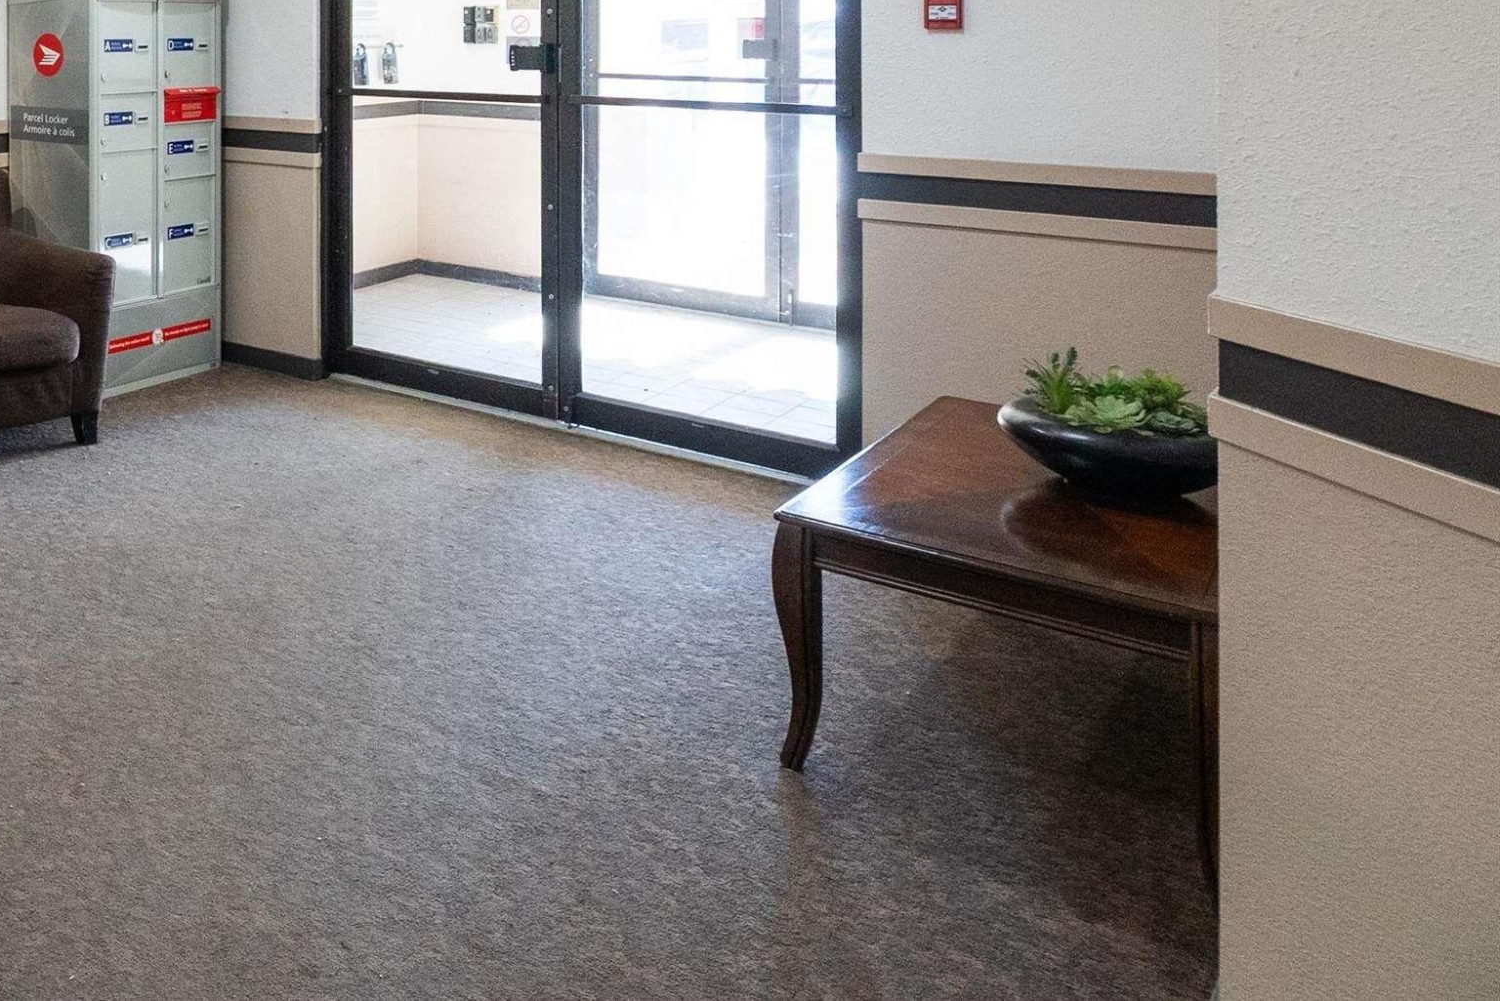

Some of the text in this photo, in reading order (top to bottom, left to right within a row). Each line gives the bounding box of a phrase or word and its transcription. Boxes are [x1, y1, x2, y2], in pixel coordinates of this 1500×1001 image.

[105, 41, 111, 51] A
[168, 40, 174, 50] D
[23, 112, 69, 124] Parcel Locker
[104, 114, 110, 125] B
[23, 124, 75, 137] Armoire à colis
[168, 143, 174, 154] E
[169, 228, 174, 239] F
